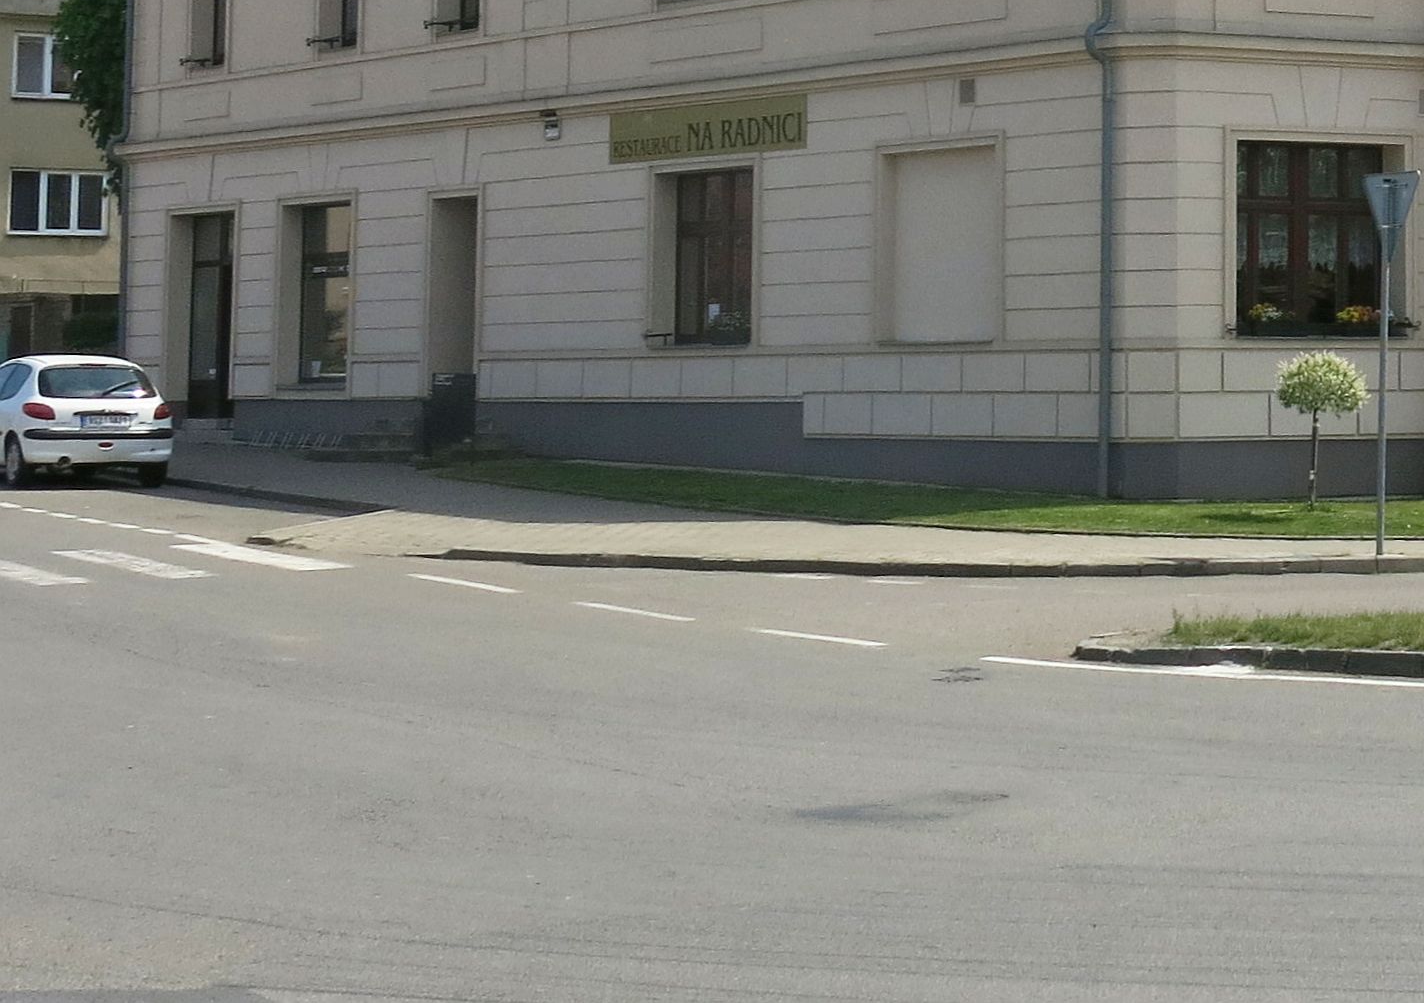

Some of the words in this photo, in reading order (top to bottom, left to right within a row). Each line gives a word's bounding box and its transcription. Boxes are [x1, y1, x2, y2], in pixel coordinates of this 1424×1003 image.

[613, 135, 682, 159] RESTAURACE
[687, 120, 714, 151] NA
[721, 112, 803, 148] RADNICI
